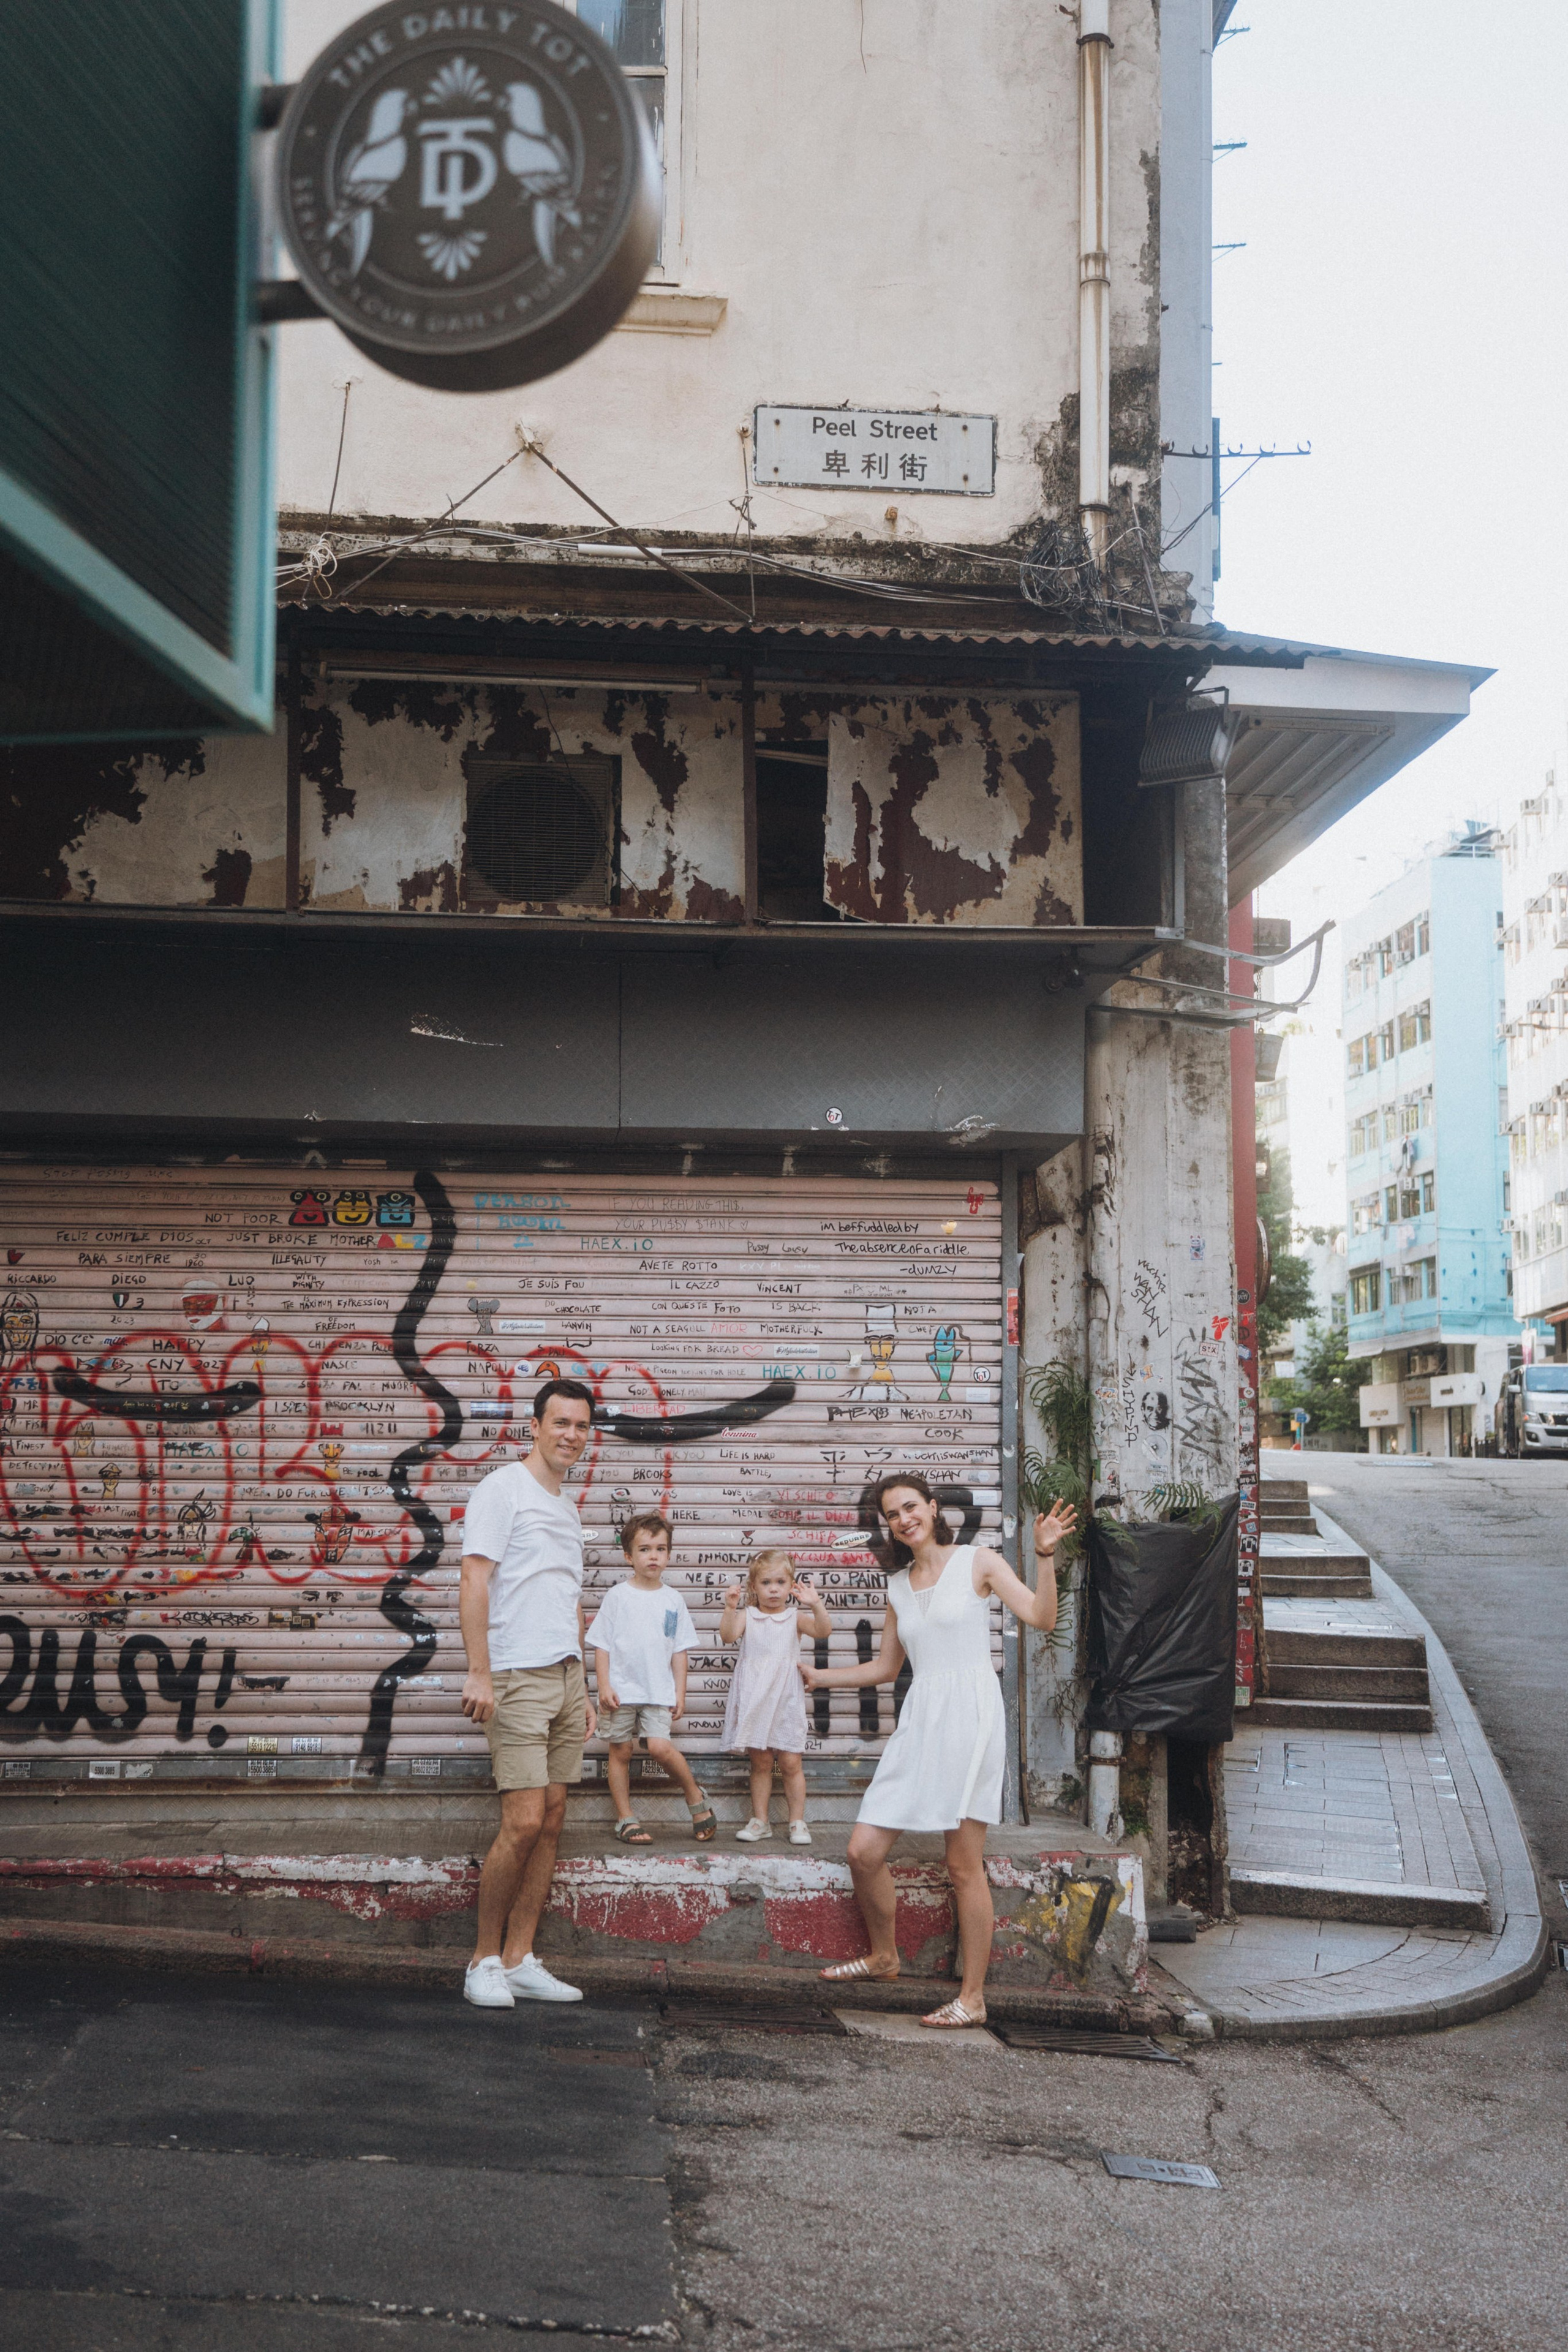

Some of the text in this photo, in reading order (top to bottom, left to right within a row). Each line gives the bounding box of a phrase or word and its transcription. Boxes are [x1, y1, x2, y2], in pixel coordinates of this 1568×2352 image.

[328, 6, 590, 88] THE DAILY TOT
[812, 417, 938, 441] Peel Street
[822, 450, 928, 482] 卑利街
[608, 1197, 624, 1210] IF
[630, 1197, 655, 1210] YOU
[205, 1213, 283, 1224] NOT POOR
[615, 1218, 646, 1231] YOUR
[56, 1231, 88, 1242] FELIZ
[96, 1232, 151, 1242] CUMPLE
[226, 1232, 377, 1246] JUST BROKE MOTHER
[78, 1252, 107, 1264] PARA
[639, 1261, 674, 1271] AVETE
[682, 1261, 718, 1271] ROTTO
[518, 1278, 533, 1289] JE
[564, 1280, 585, 1289] FOU
[685, 1280, 720, 1289] CAZZO
[281, 1300, 294, 1310] THE
[555, 1305, 602, 1314] CHOCOLATE
[652, 1301, 741, 1314] CON QUESTE FOTO
[315, 1322, 356, 1331] FREEDOM
[630, 1324, 706, 1335] NOT A SEAGULL
[711, 1324, 747, 1334] AMOR
[153, 1339, 205, 1352] HAPPY
[466, 1340, 500, 1353] FORZA
[147, 1358, 228, 1371] CNY 2023
[621, 1403, 686, 1415] LIBERTAD
[482, 1426, 531, 1438] NO ONE
[722, 1427, 758, 1439] tonnina
[925, 1428, 963, 1442] COOK
[490, 1445, 507, 1455] CAN
[754, 1452, 775, 1460] HARD
[633, 1469, 673, 1480] BROOKS
[673, 1510, 700, 1520] HERE
[733, 1509, 763, 1518] MEDAL
[835, 1533, 870, 1547] SEDURRE
[676, 1554, 690, 1564] BE
[686, 1572, 727, 1587] NEED
[820, 1572, 840, 1586] TO
